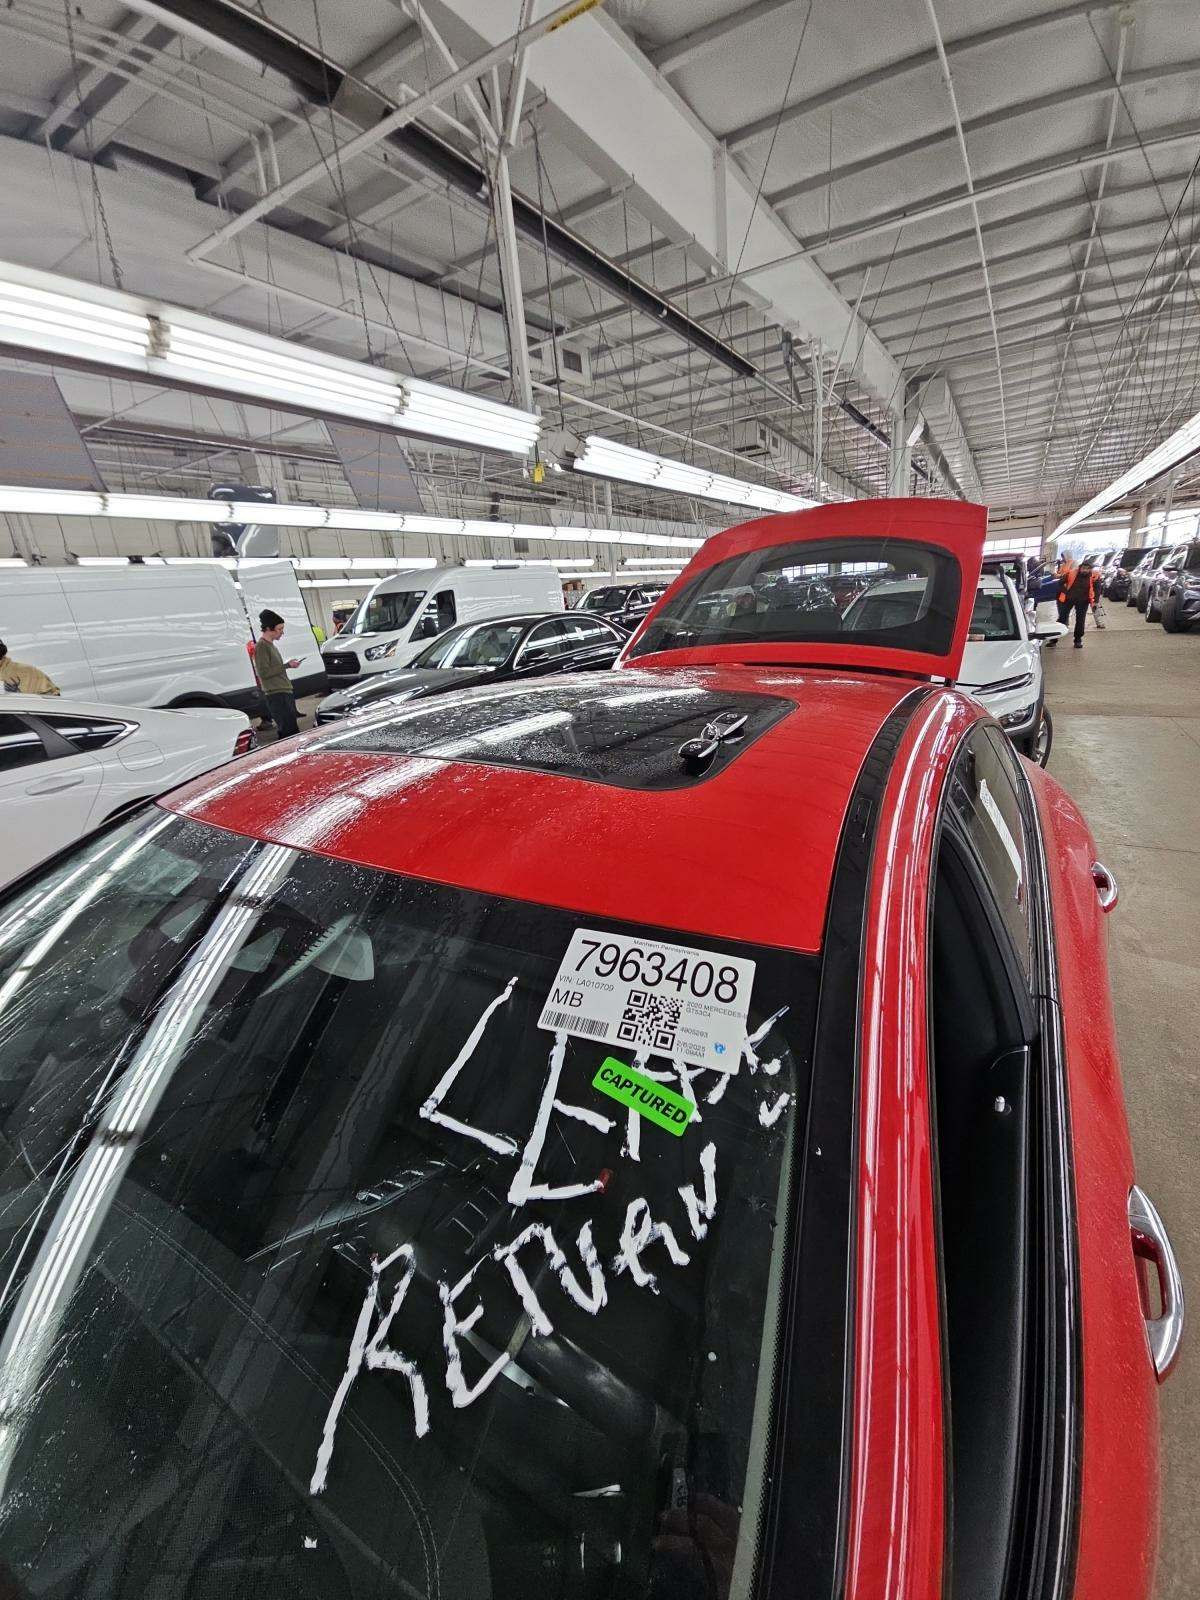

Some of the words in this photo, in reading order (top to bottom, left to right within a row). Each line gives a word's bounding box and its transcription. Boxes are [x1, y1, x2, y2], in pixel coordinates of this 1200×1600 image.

[633, 939, 660, 949] Manheim
[660, 944, 700, 957] Pennsylvania
[574, 939, 740, 1004] 7963408
[576, 977, 615, 992] LA010709
[551, 988, 584, 1008] MB
[600, 1067, 688, 1125] CAPTURED
[309, 1142, 718, 1495] RETURN
